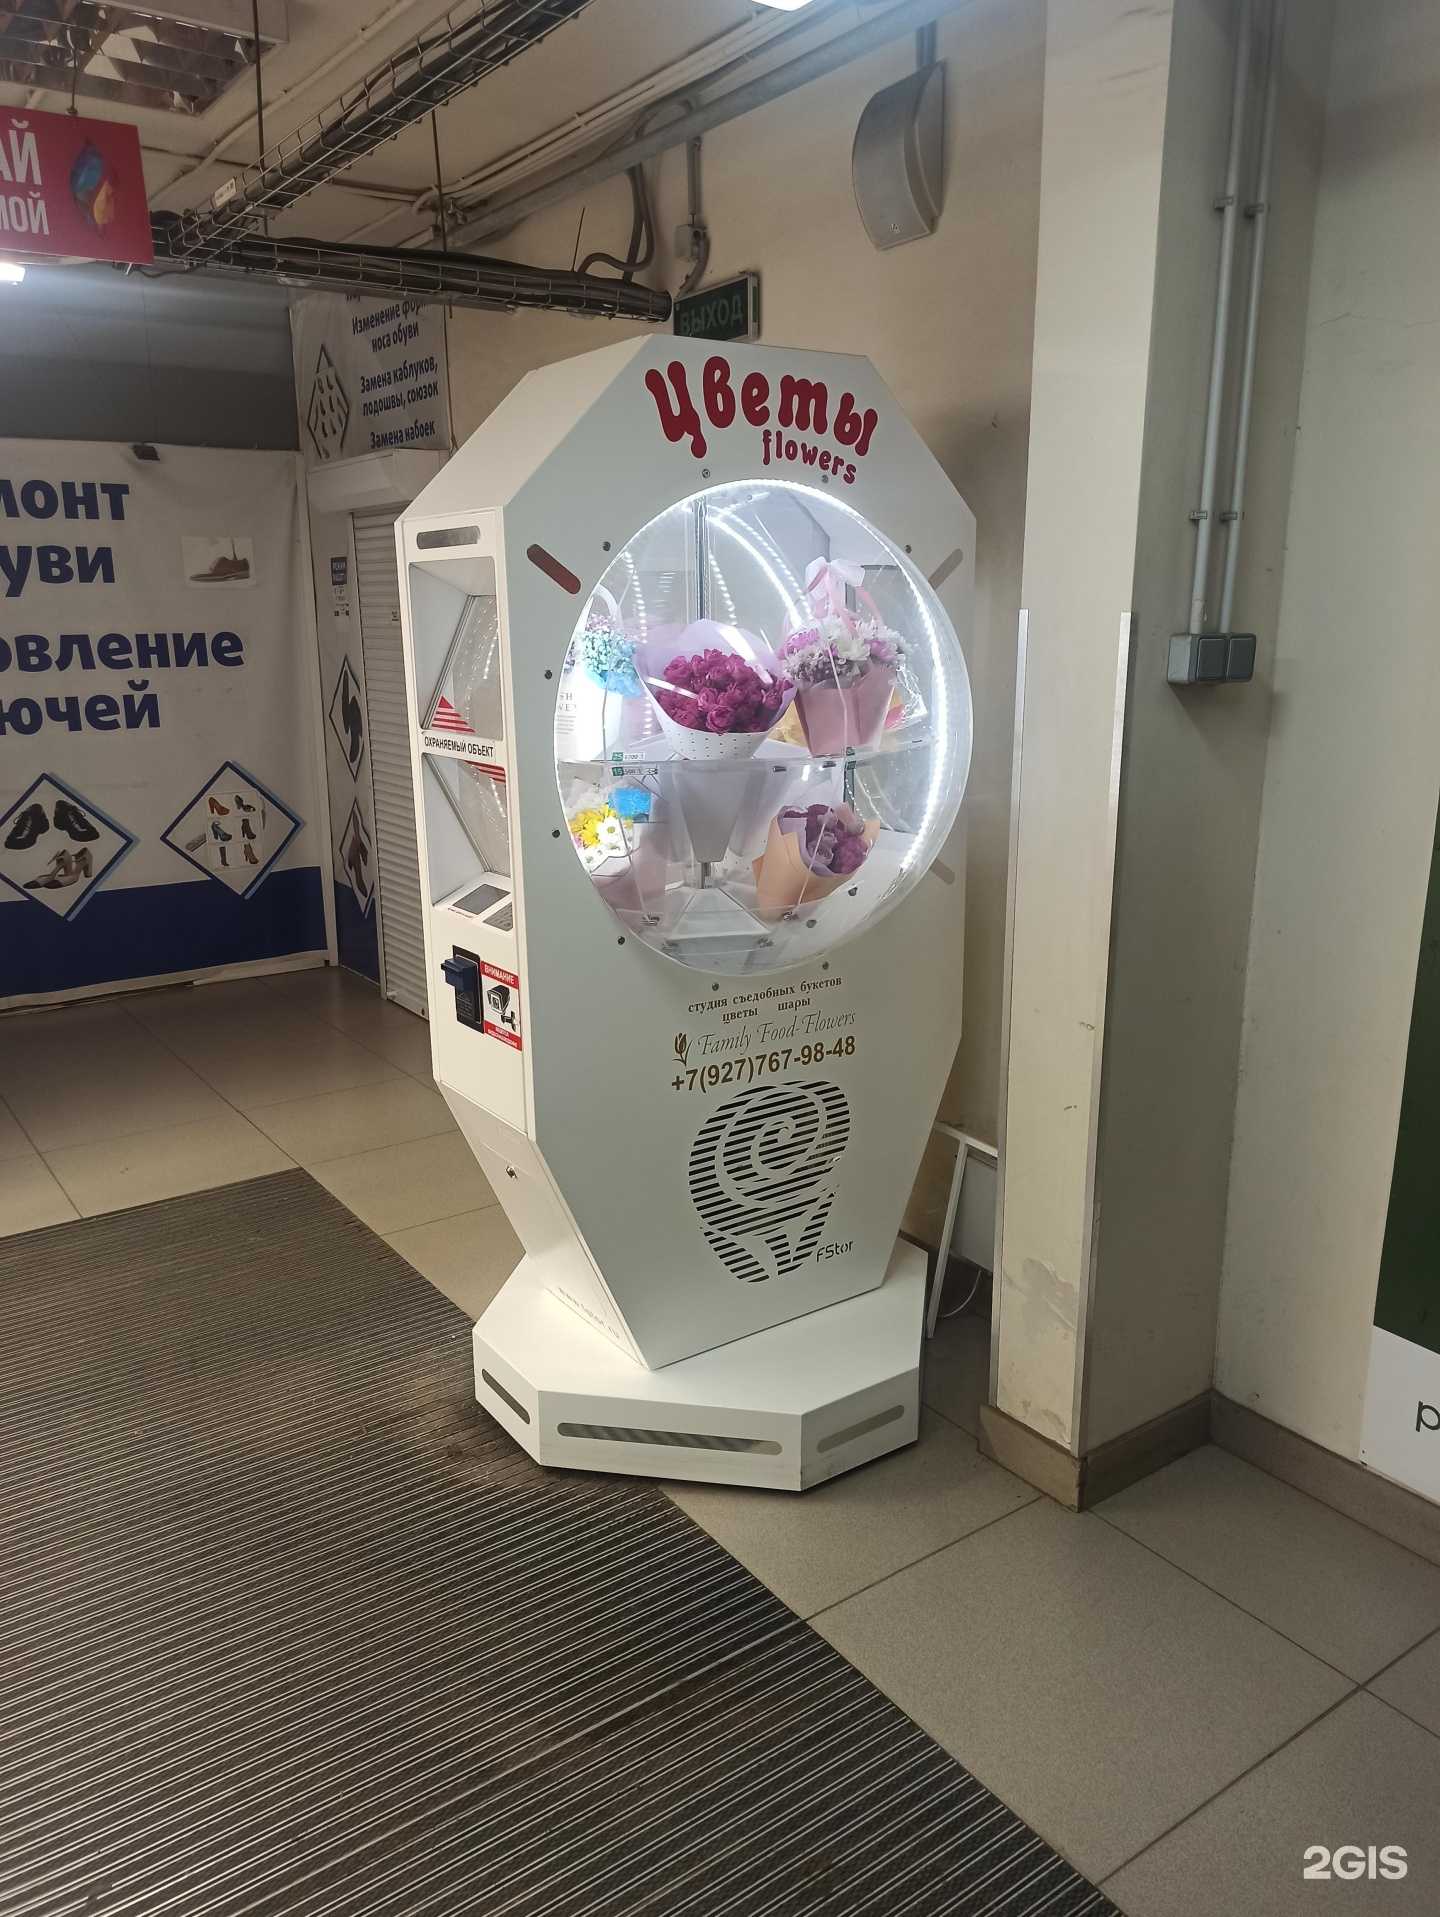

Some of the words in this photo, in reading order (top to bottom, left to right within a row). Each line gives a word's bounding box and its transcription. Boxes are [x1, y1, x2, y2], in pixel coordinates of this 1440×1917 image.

[352, 303, 400, 336] Изменение
[681, 294, 743, 335] ВЫХОД
[371, 331, 391, 352] носа
[393, 321, 419, 346] обуви
[360, 371, 392, 394] Замена
[393, 356, 438, 383] каблуков,
[363, 392, 406, 417] подошвы,
[407, 382, 438, 404] союзок
[644, 356, 878, 459] Цветы
[370, 427, 404, 449] Замена
[405, 420, 435, 442] набоек
[762, 429, 857, 485] flowers
[424, 736, 466, 753] ОХРАНЯЕМЫЙ
[467, 743, 494, 757] ОБЪЕКТ
[484, 964, 515, 985] ВНИМАНИЕ
[688, 997, 728, 1014] студия
[732, 986, 795, 1005] съедобных
[800, 976, 842, 993] букетов
[722, 1008, 758, 1024] цветы
[778, 997, 811, 1012] шары
[697, 1025, 752, 1056] Family
[671, 1036, 856, 1093] +7(927)767-98-48
